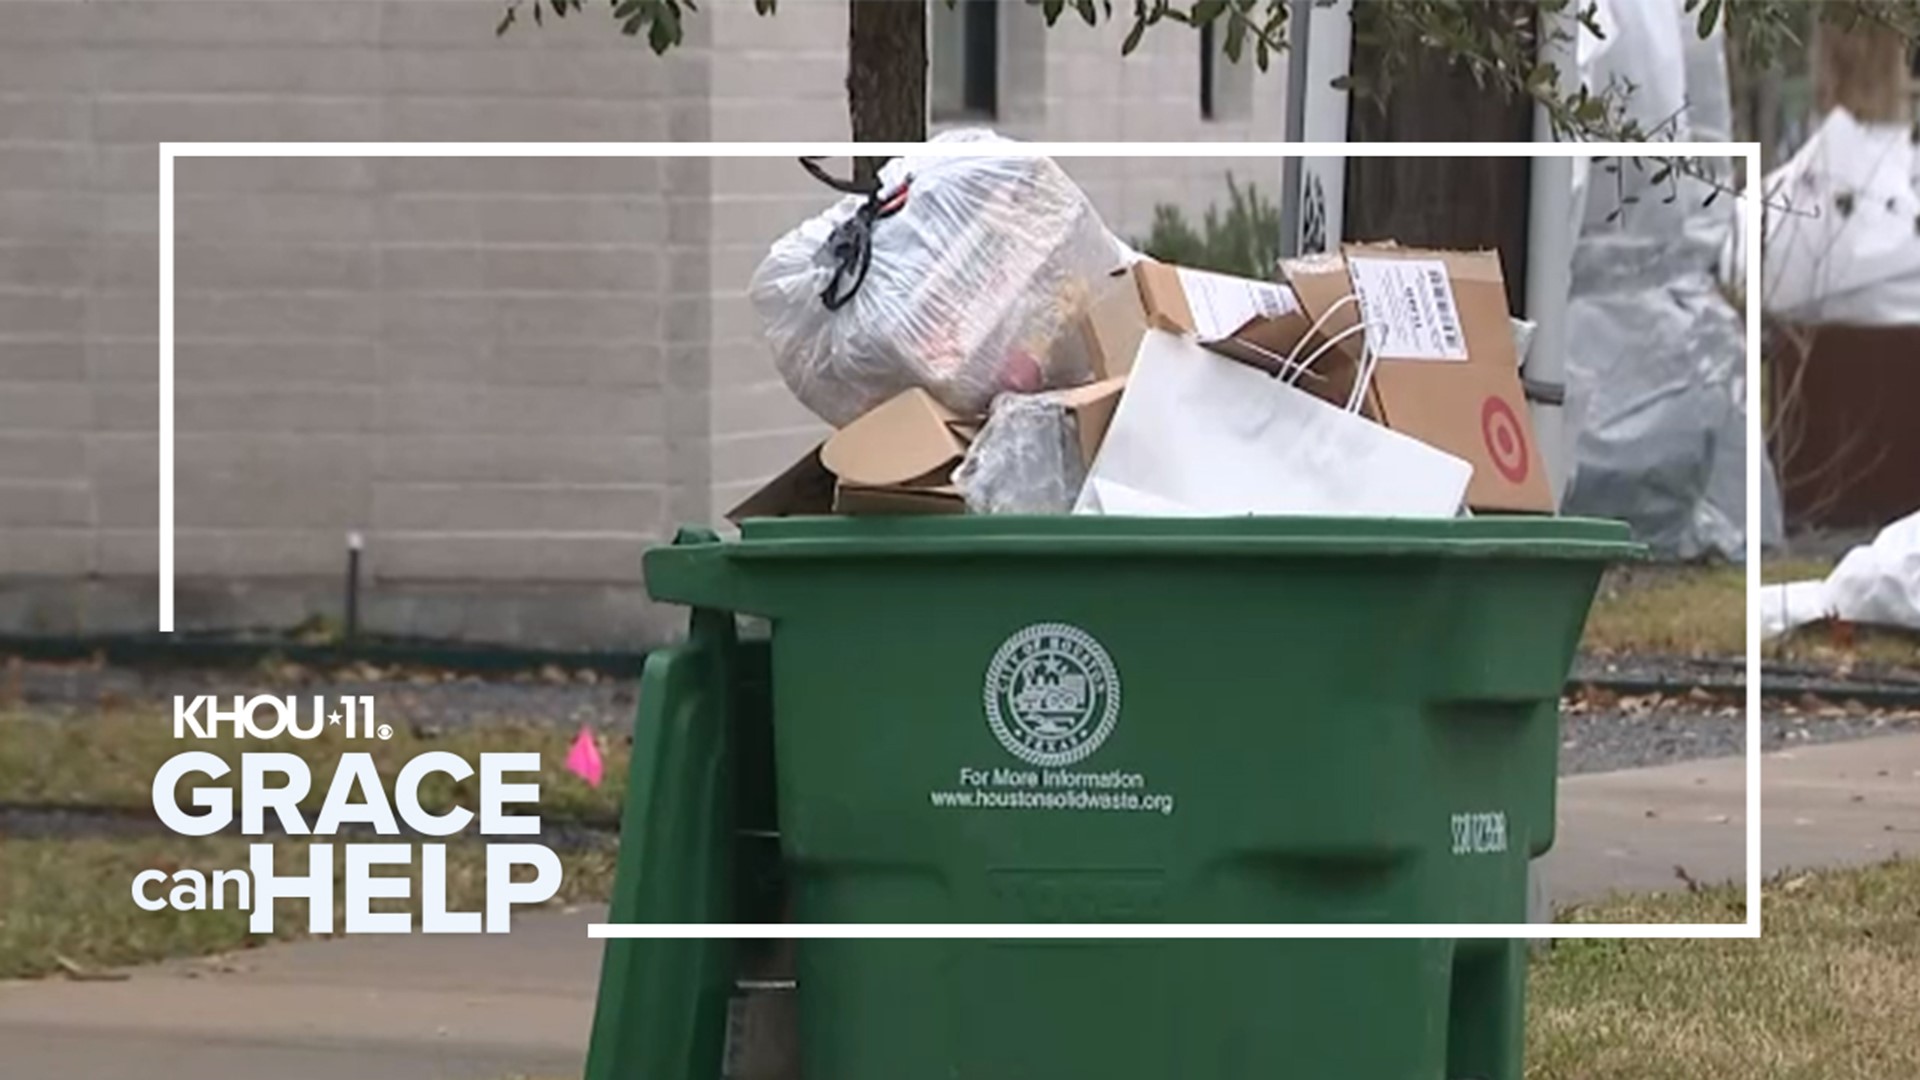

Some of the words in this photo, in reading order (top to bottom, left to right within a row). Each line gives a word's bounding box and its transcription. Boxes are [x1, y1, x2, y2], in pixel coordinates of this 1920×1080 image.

[960, 768, 990, 786] For
[992, 768, 1038, 787] More
[1042, 768, 1144, 789] Information
[930, 789, 1173, 814] www.houstonsolidwaste.org
